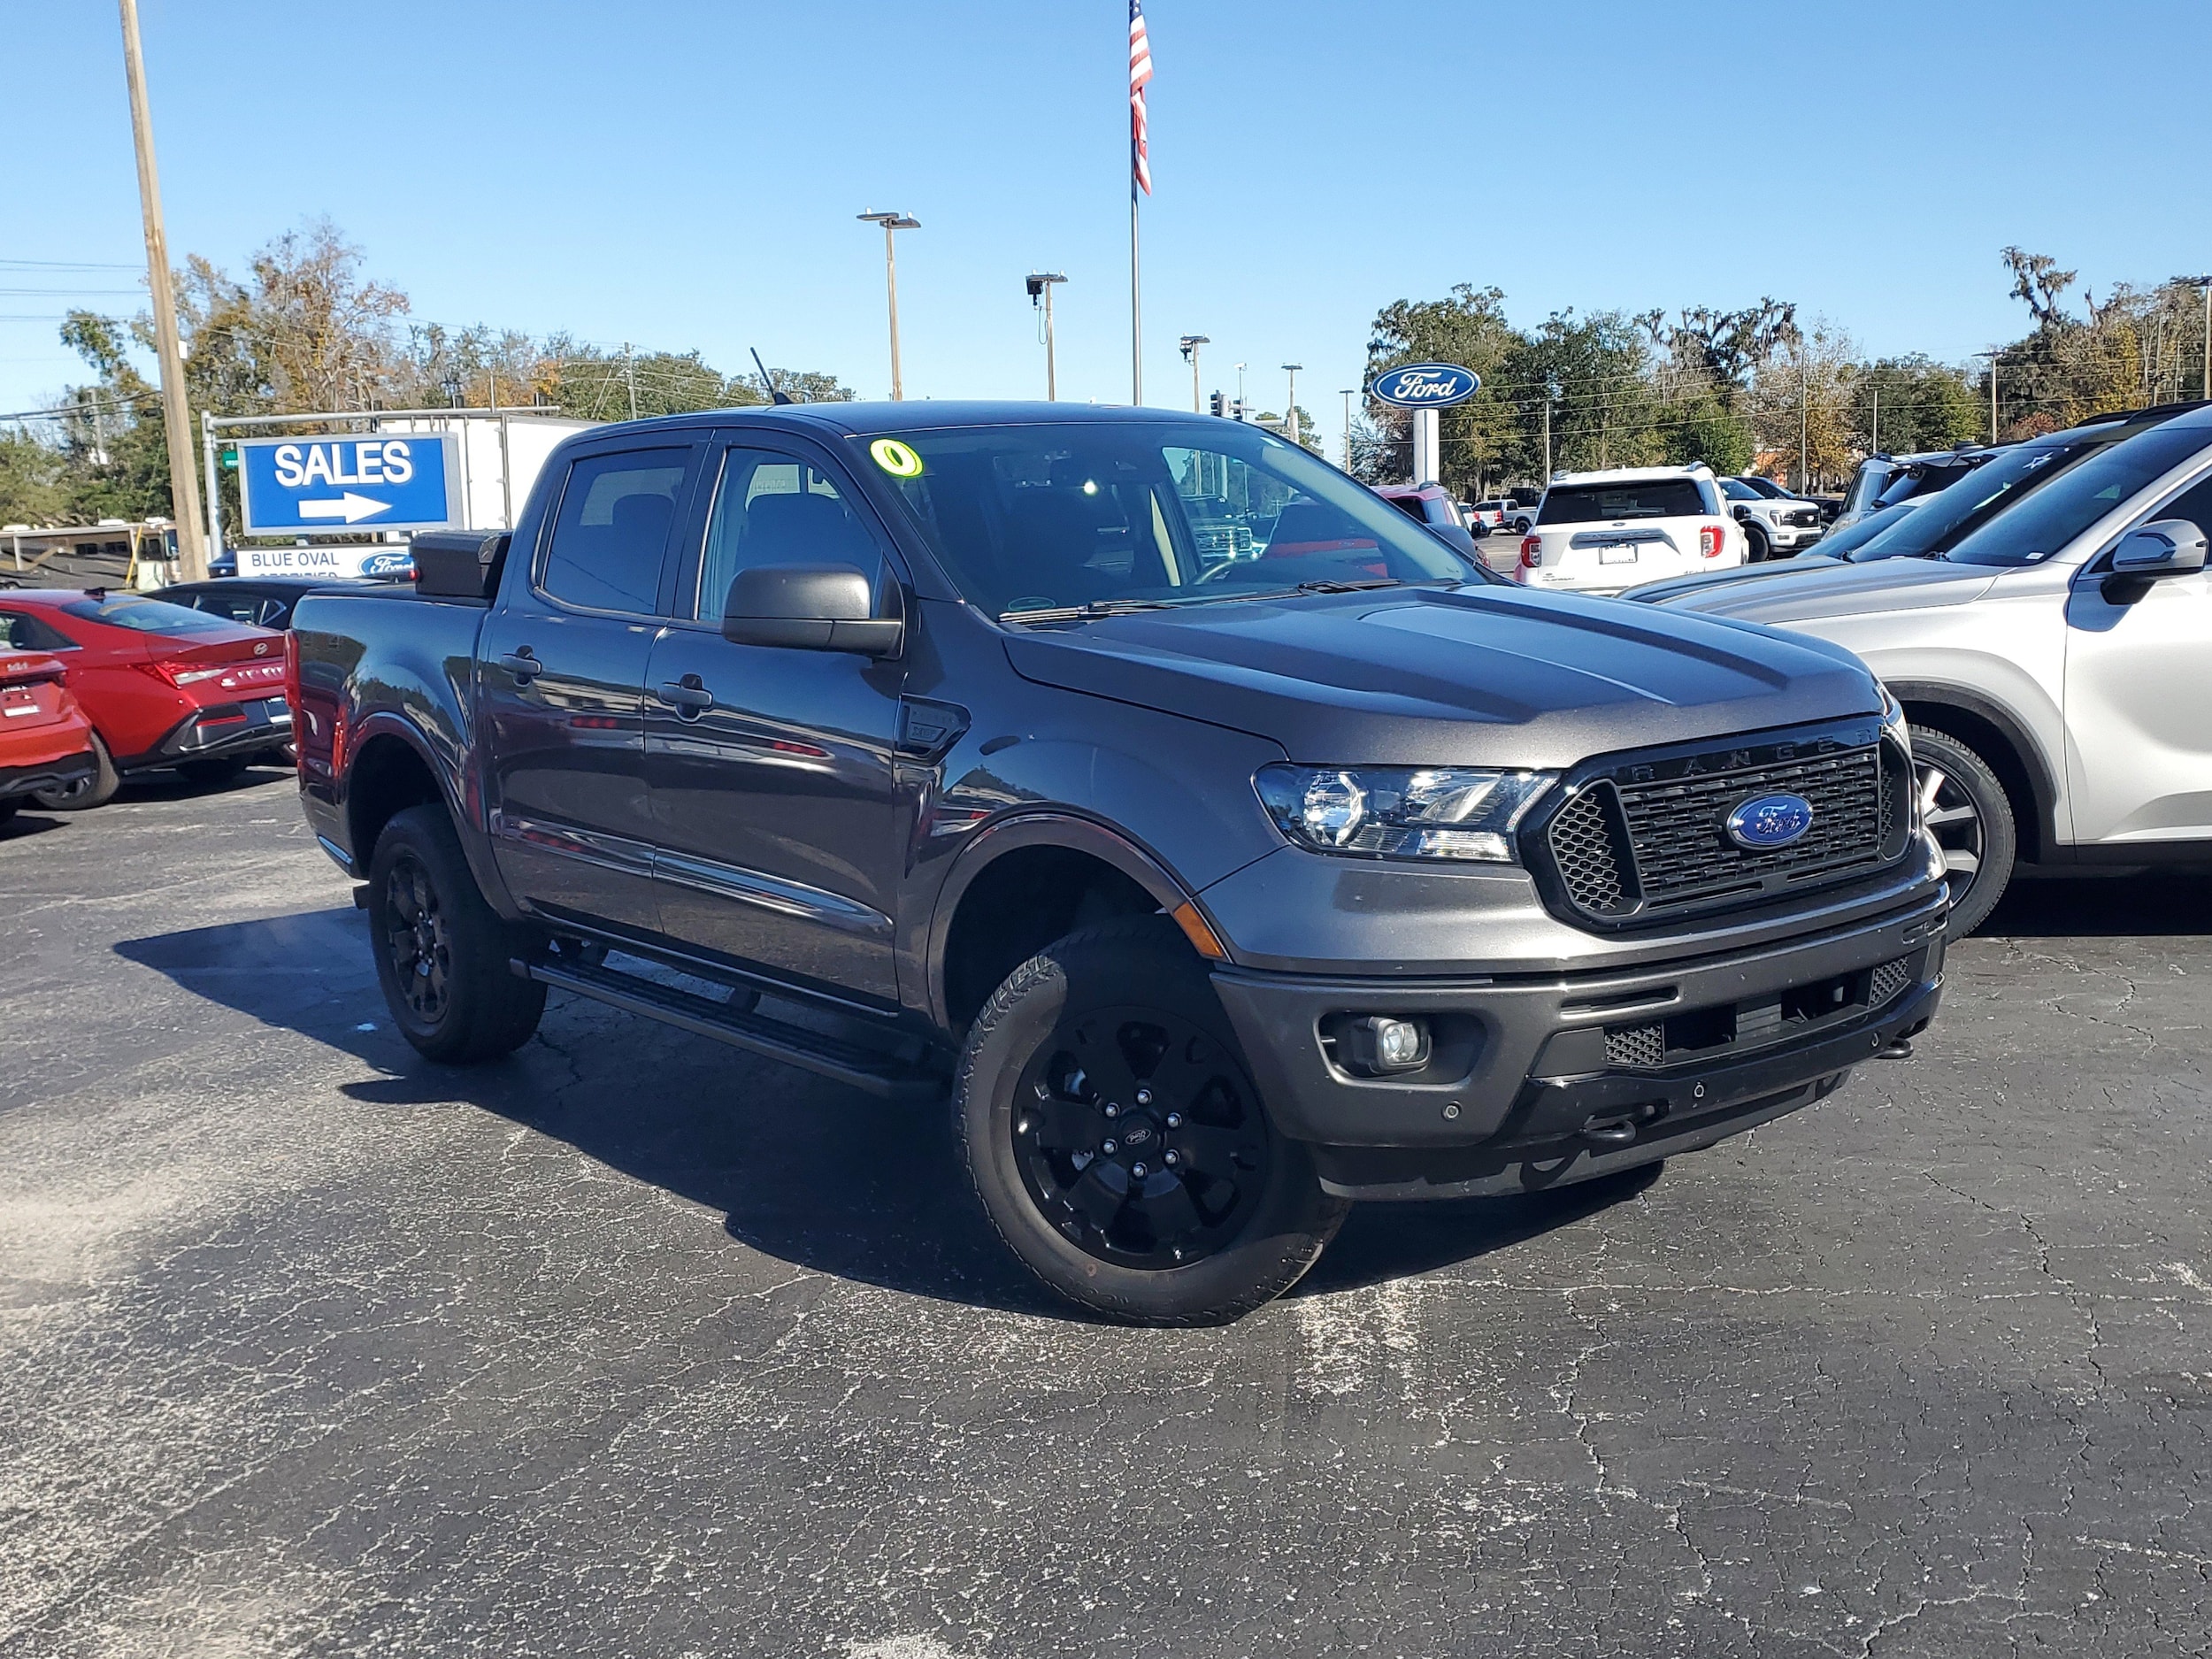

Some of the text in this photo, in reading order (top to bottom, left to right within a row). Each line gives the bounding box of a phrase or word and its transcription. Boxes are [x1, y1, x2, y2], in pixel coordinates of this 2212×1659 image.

[1394, 372, 1457, 398] Ford
[274, 441, 412, 487] SALES
[251, 552, 340, 567] BLUE OVAL
[1631, 729, 1872, 781] RANGER
[1756, 803, 1801, 835] Ford
